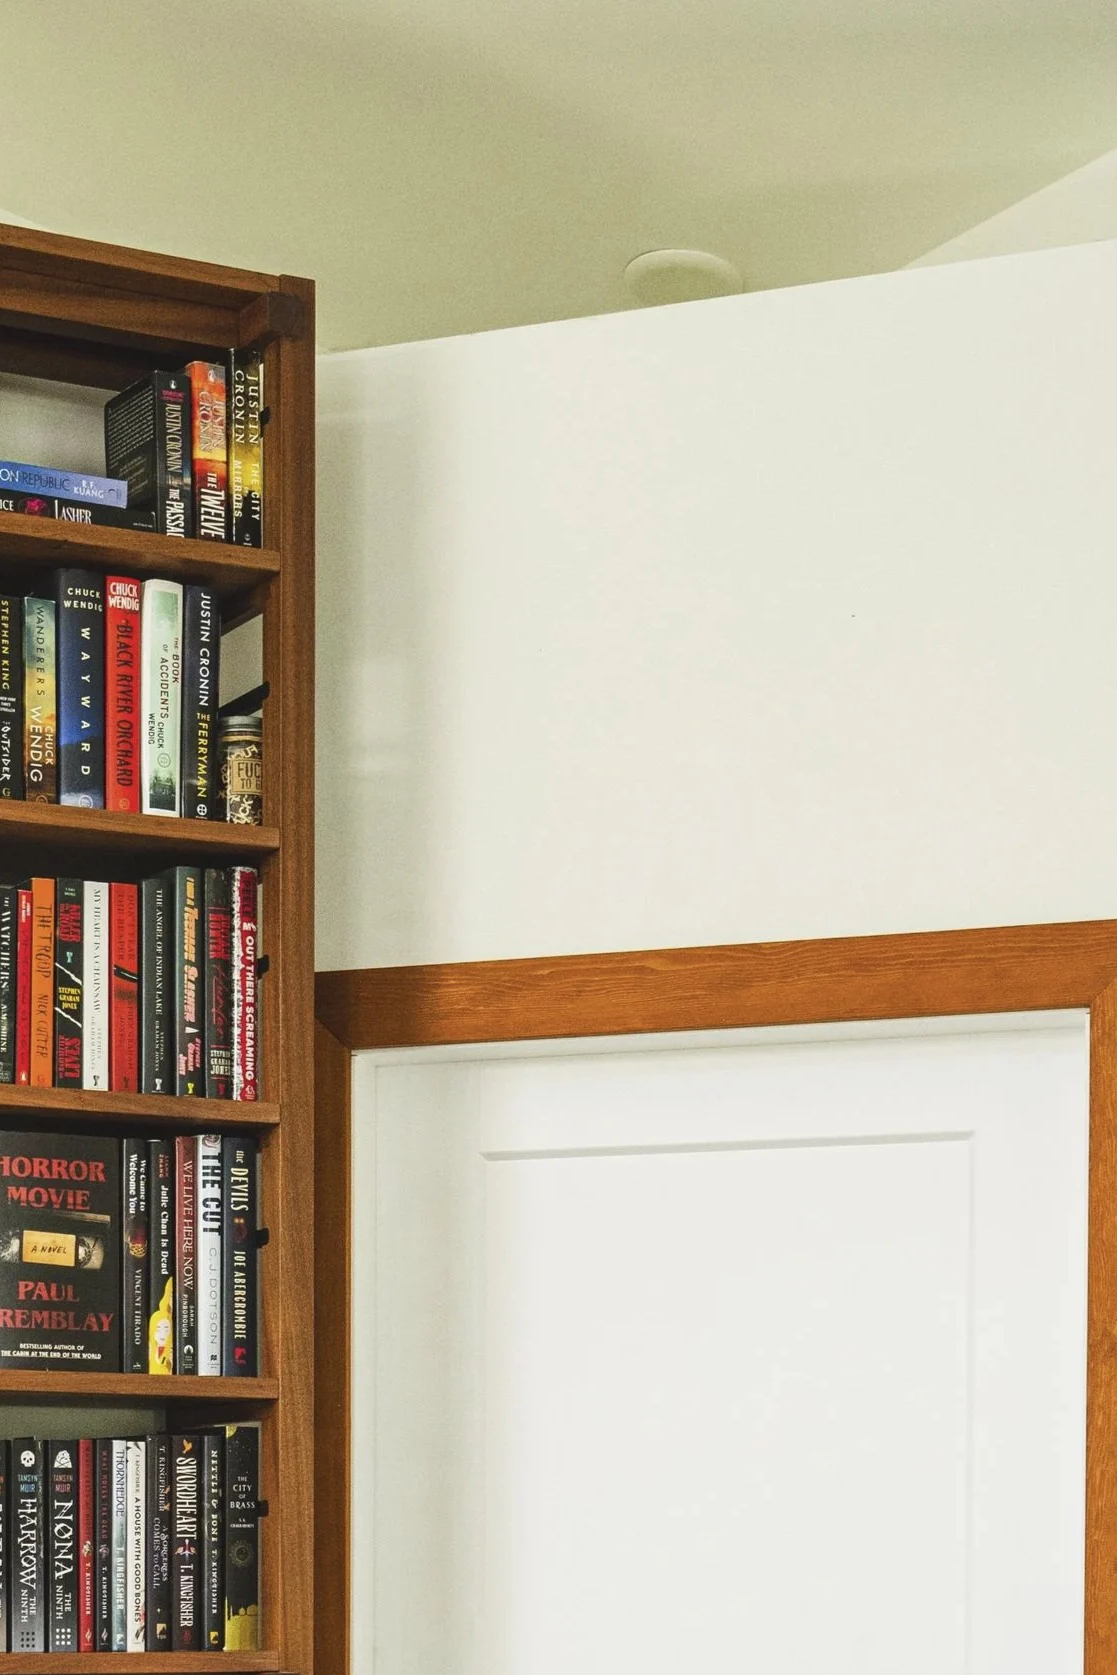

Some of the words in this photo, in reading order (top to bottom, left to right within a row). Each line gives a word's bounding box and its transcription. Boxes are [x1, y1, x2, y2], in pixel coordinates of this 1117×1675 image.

[233, 370, 246, 444] CRONIN
[247, 374, 258, 446] JUSTIN
[21, 472, 70, 492] REPUBLIC
[200, 488, 225, 540] TWELVE
[199, 592, 211, 643] JUSTIN
[116, 622, 132, 668] BLACK
[116, 673, 133, 714] RIVER
[198, 647, 210, 706] CRONIN
[197, 712, 210, 721] THE
[115, 719, 133, 787] ORCHARD
[196, 722, 210, 798] FERRYMAN
[246, 936, 254, 958] OUT
[246, 963, 254, 1003] THERE
[245, 1007, 254, 1081] SCREAMING
[203, 1154, 221, 1188] THE
[7, 1187, 91, 1211] MOVIE
[203, 1197, 221, 1236] CUT
[31, 1245, 38, 1254] A
[41, 1244, 68, 1254] NOVEL
[18, 1280, 79, 1301] PAUL
[175, 1457, 197, 1539] SWORDHEART
[230, 1500, 255, 1509] BRASS
[232, 1484, 252, 1492] CITY
[181, 1565, 193, 1573] T.
[180, 1576, 193, 1627] KINGFISHER
